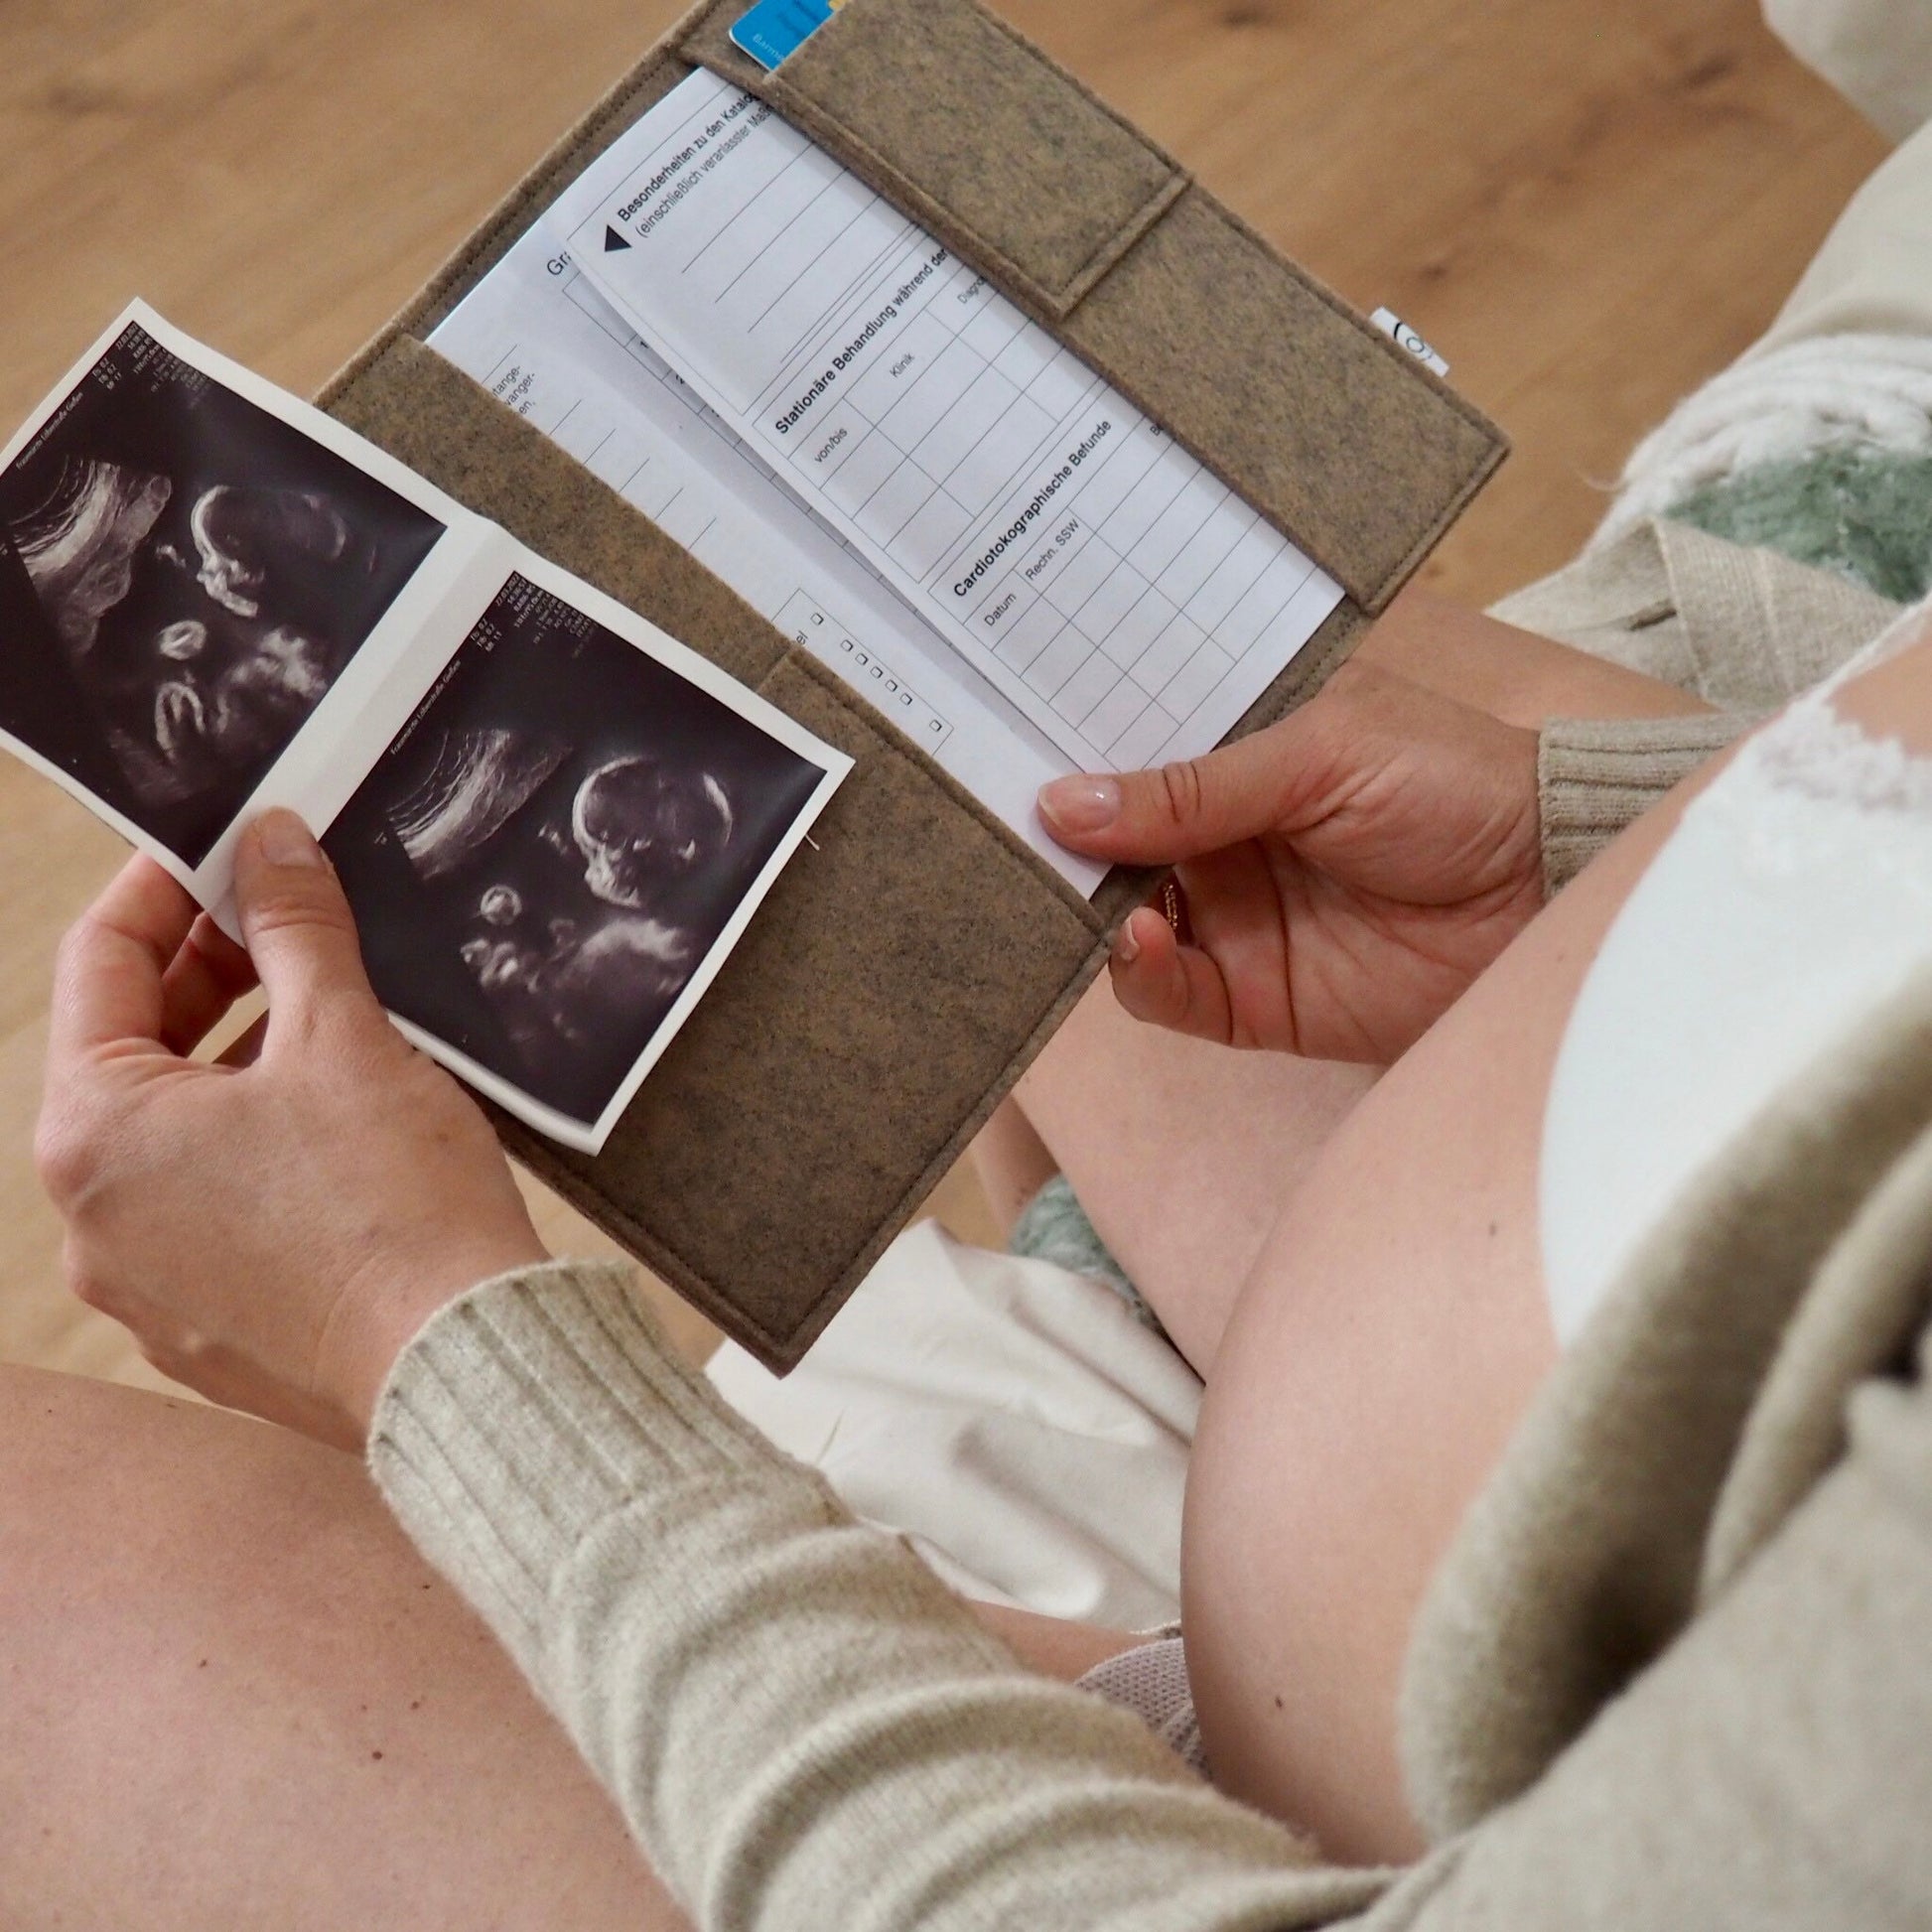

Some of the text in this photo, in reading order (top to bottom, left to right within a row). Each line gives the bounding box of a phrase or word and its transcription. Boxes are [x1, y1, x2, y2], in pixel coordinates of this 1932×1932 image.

[752, 33, 785, 61] Barme
[618, 146, 696, 222] Besonderheiten
[693, 134, 708, 150] zu
[706, 119, 726, 138] den
[635, 169, 704, 238] (einschließlich
[701, 125, 752, 173] veranlasster
[546, 251, 572, 276] Gr
[775, 368, 836, 435] Stationäre
[832, 304, 897, 370] Behandlung
[893, 263, 933, 307] während
[890, 351, 915, 378] Klinik
[518, 400, 536, 416] en,
[814, 428, 848, 463] von/bis
[954, 420, 1112, 598] Cardiotokographische Befunde
[1025, 518, 1080, 581] Rechn. SSW
[984, 592, 1018, 627] Datum
[796, 629, 808, 644] el
